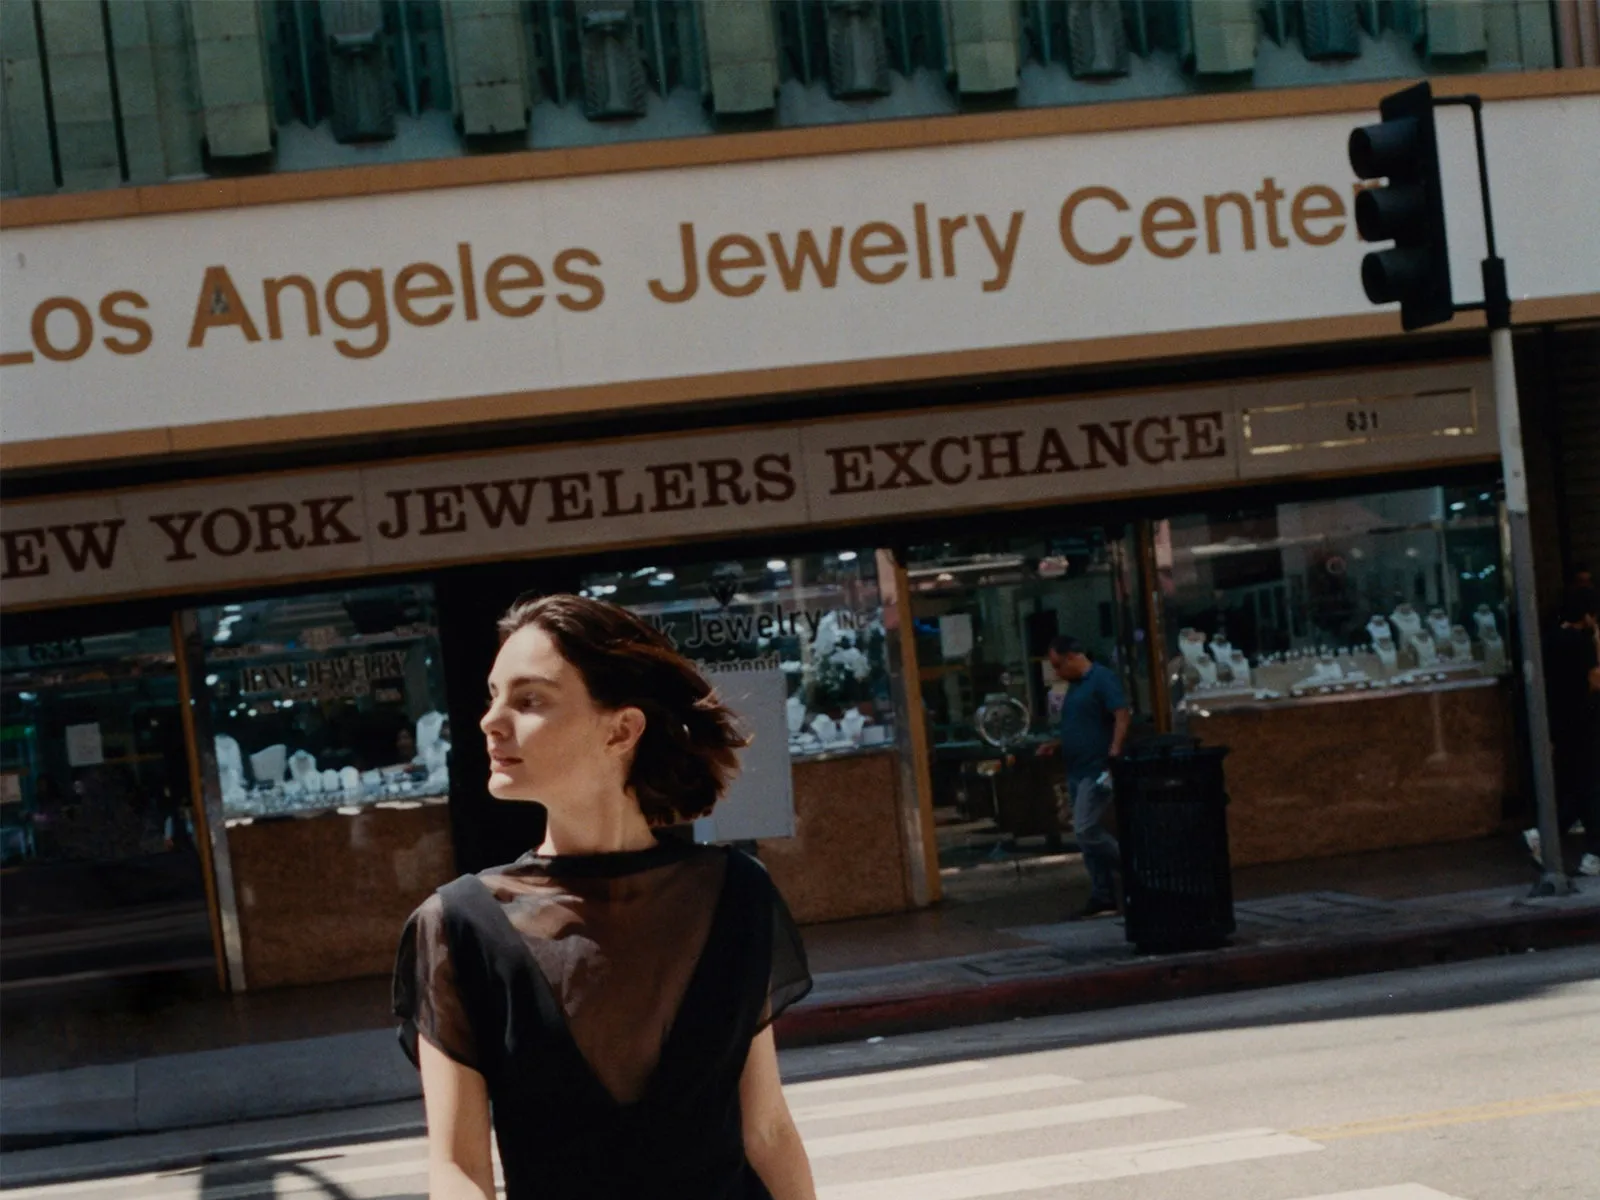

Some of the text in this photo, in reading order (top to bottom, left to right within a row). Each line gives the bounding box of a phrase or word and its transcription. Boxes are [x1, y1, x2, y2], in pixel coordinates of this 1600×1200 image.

[188, 242, 606, 360] Angeles
[648, 202, 1024, 303] Jewelry
[1058, 177, 1380, 267] Cente
[1345, 410, 1379, 432] 631
[149, 494, 362, 563] YORK
[378, 453, 796, 540] JEWELERS
[825, 411, 1227, 496] EXCHANGE
[685, 602, 821, 648] Jewelry
